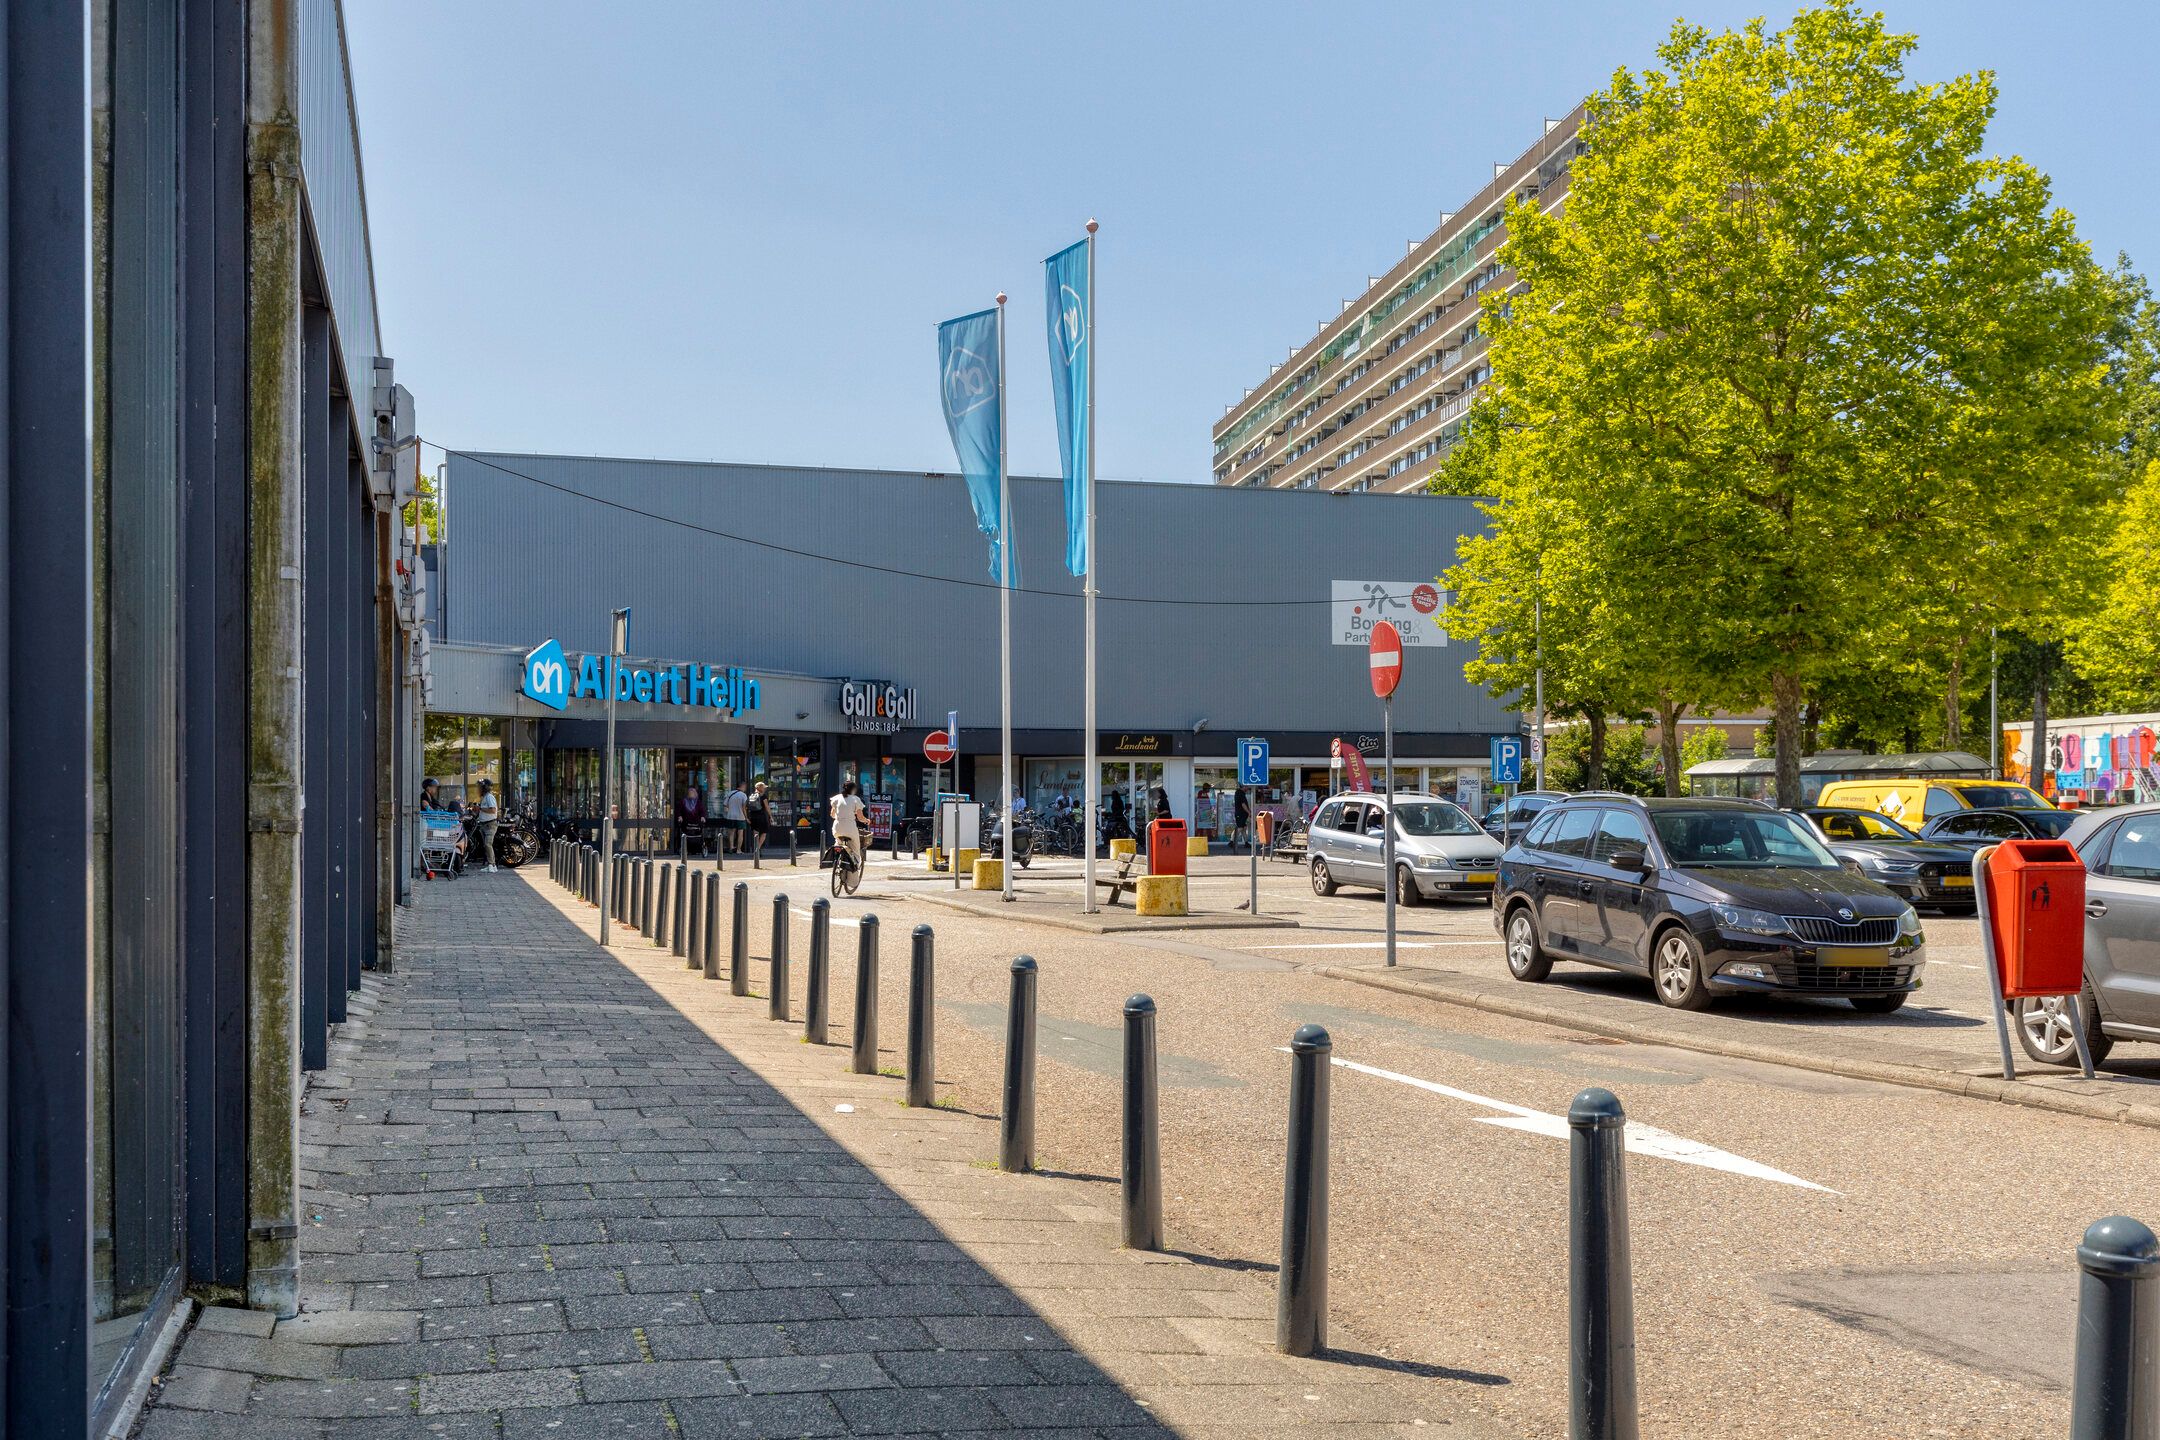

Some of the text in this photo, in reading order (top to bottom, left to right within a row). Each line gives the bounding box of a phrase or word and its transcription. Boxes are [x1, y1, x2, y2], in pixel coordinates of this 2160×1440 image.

[576, 655, 761, 718] Albert Heijn
[855, 721, 900, 732] SINDS 1884
